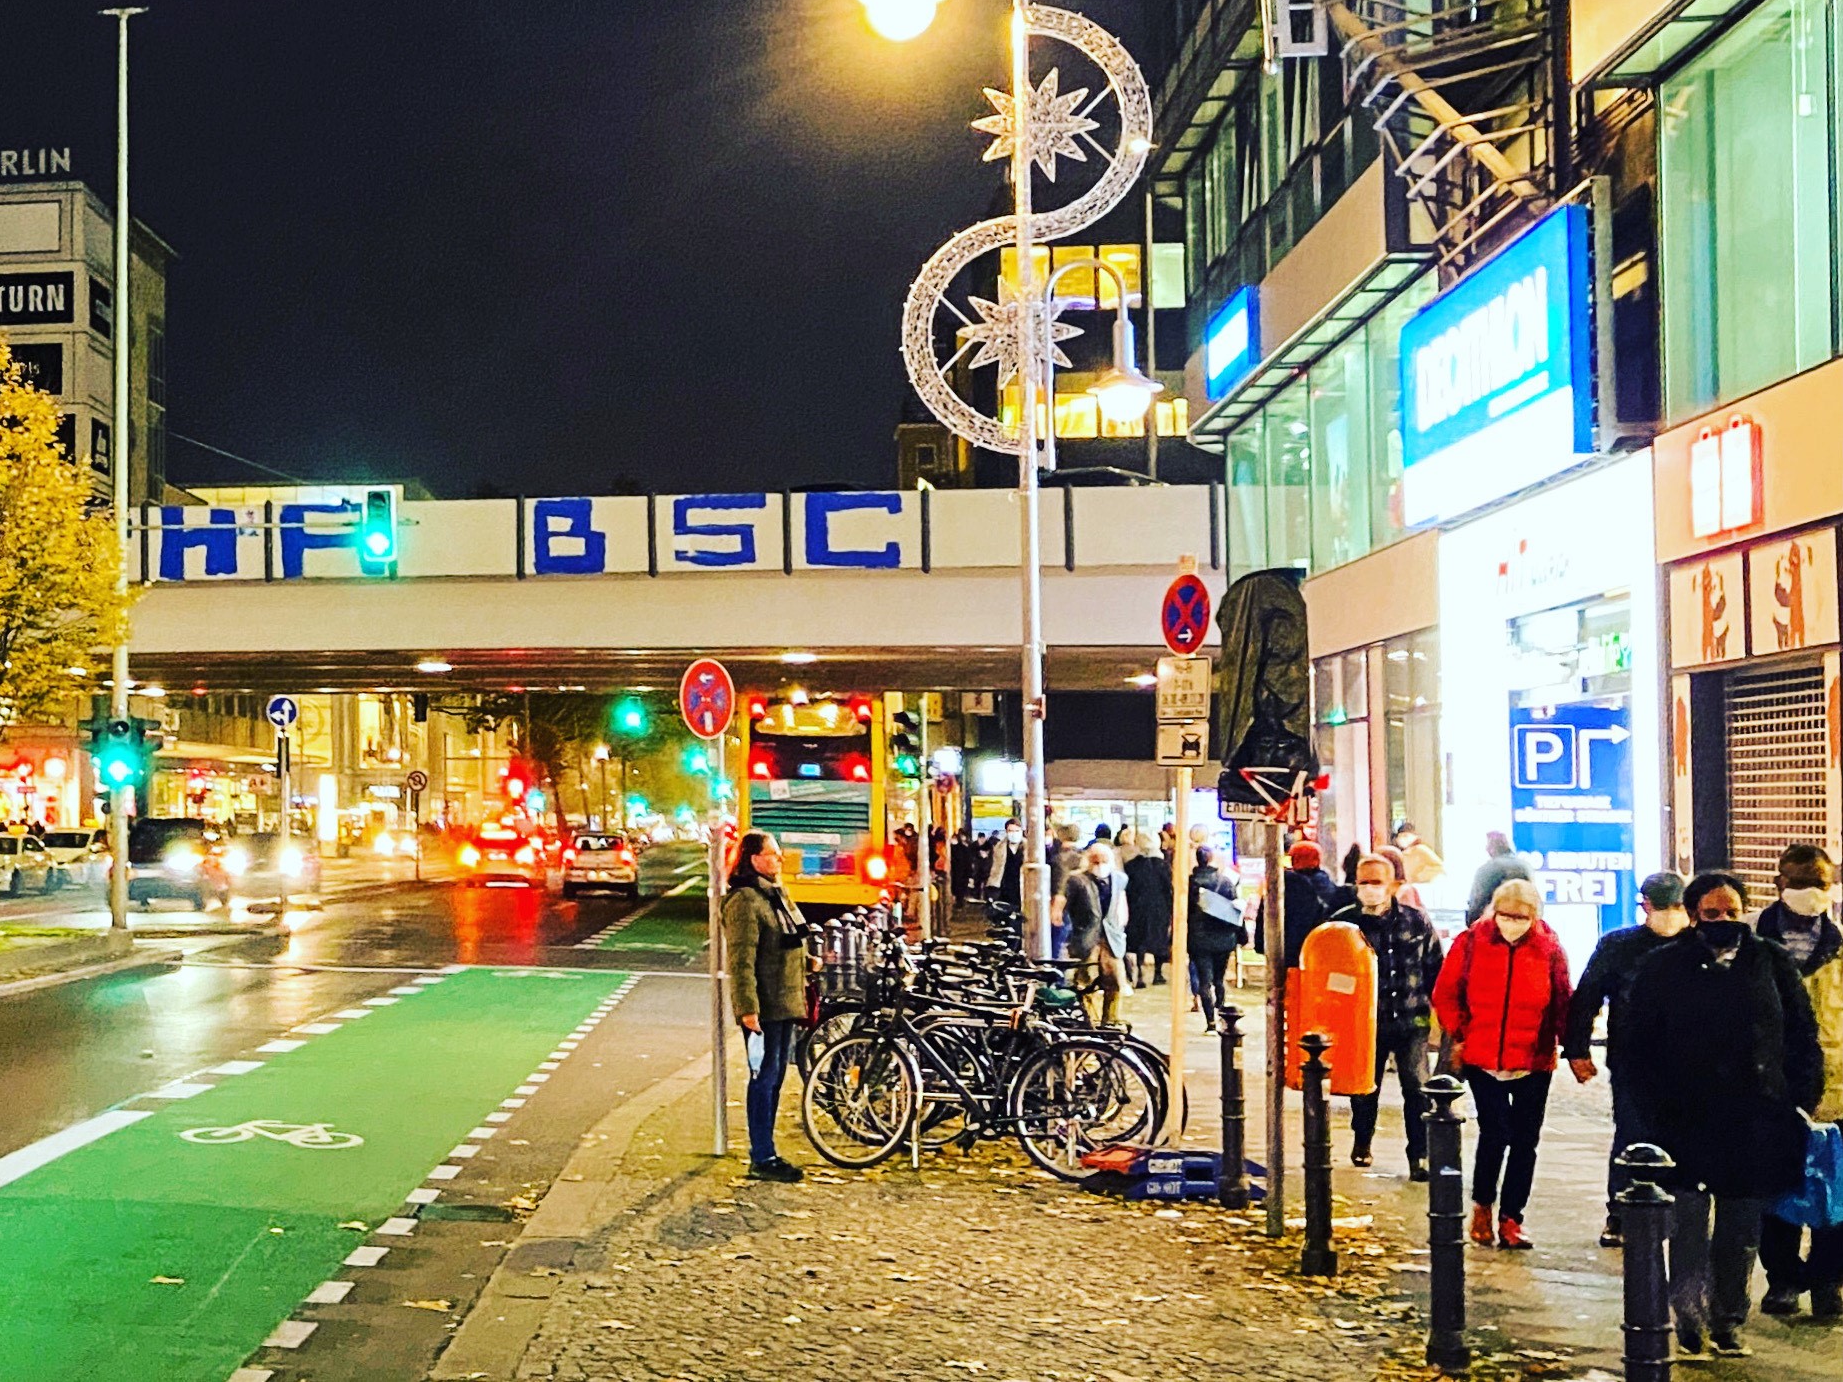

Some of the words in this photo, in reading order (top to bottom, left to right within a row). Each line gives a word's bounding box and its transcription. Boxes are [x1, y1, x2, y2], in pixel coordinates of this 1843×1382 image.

[1524, 731, 1565, 782] P
[1547, 850, 1633, 871] MINUTEN
[1535, 871, 1618, 904] FREI
